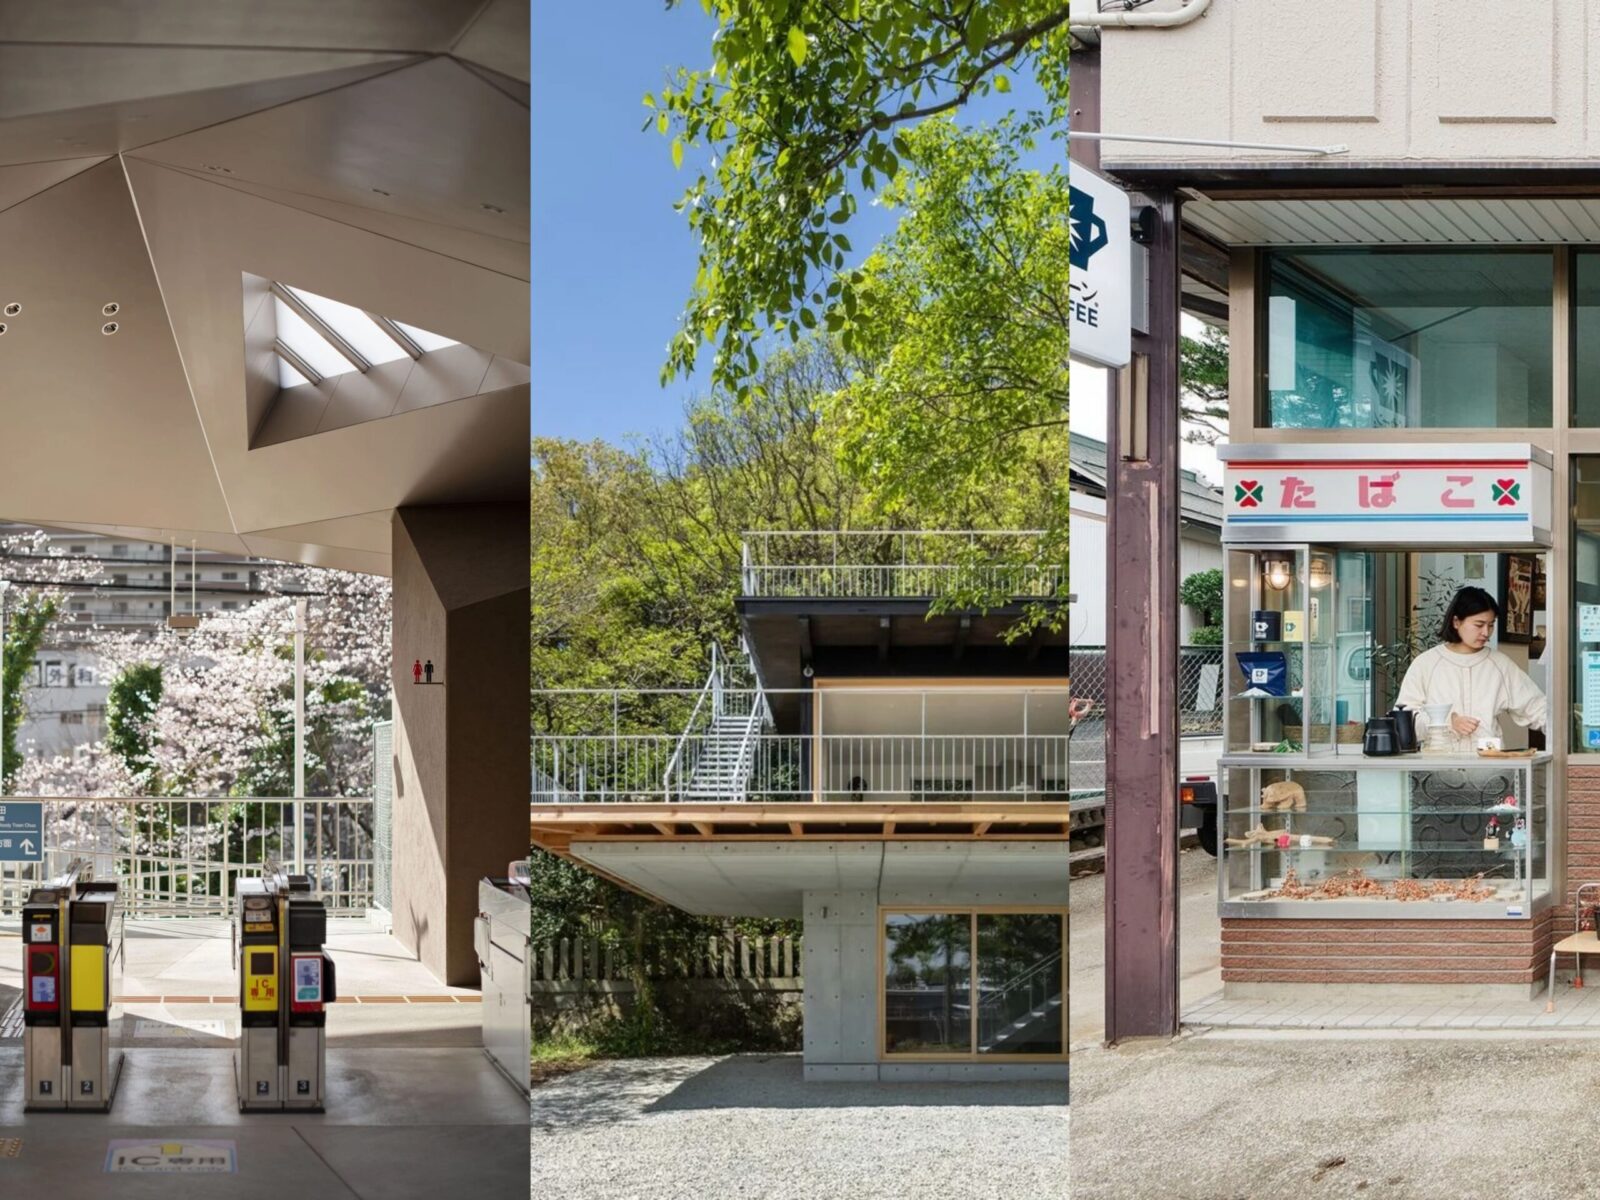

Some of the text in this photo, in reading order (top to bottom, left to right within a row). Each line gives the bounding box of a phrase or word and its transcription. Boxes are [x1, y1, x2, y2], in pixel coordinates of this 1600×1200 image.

[1280, 471, 1475, 508] たばこ
[255, 979, 269, 989] IC
[42, 1081, 49, 1091] 1
[83, 1081, 91, 1091] 2
[259, 1081, 267, 1091] 2
[299, 1081, 307, 1091] 3
